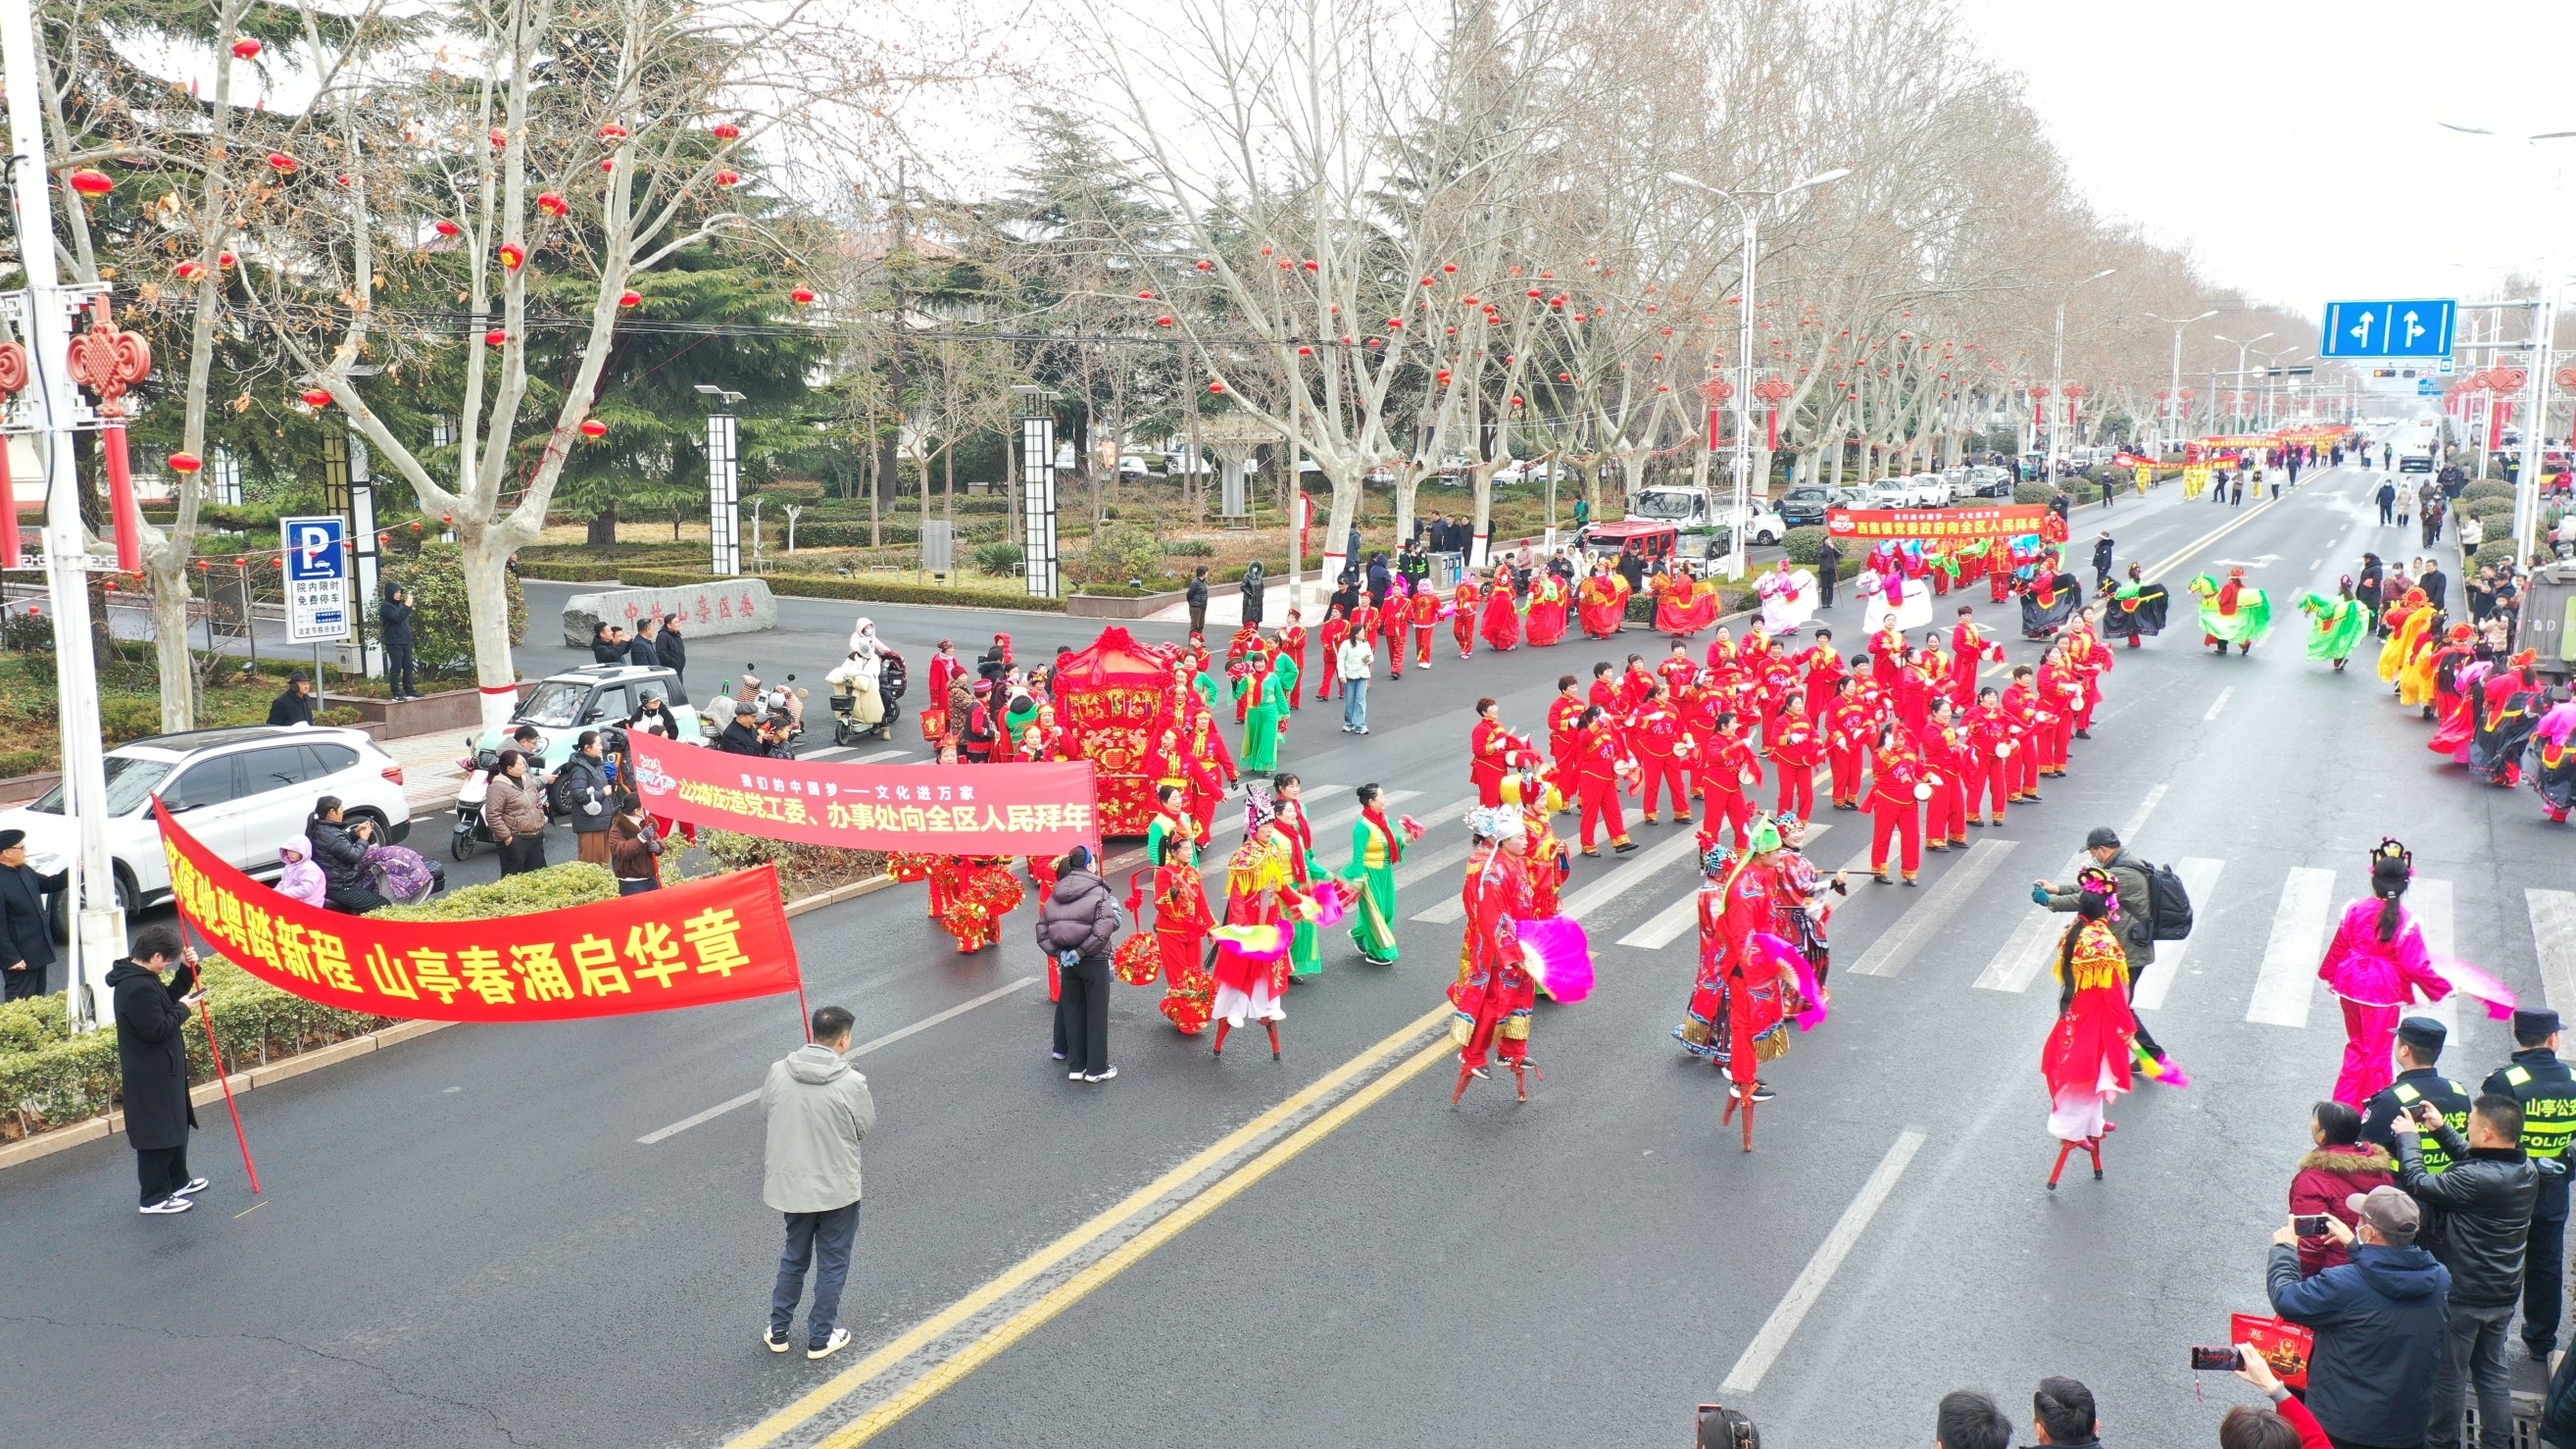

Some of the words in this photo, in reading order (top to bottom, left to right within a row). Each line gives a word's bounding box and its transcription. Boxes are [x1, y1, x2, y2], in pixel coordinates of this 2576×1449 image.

[1857, 518, 2041, 535] 西集镇党委政府向全区人民拜年
[301, 526, 329, 570] P
[297, 581, 339, 593] 院内限时
[298, 593, 340, 606] 免费停车
[298, 625, 342, 635] 法定节假日全天
[740, 774, 975, 801] 我们的中国梦——文化进万家
[678, 777, 1092, 833] 山城街道党工委、办事处向全区人民拜年
[367, 908, 750, 1005] 山亭春涌启华章
[2519, 1132, 2572, 1148] POLICE
